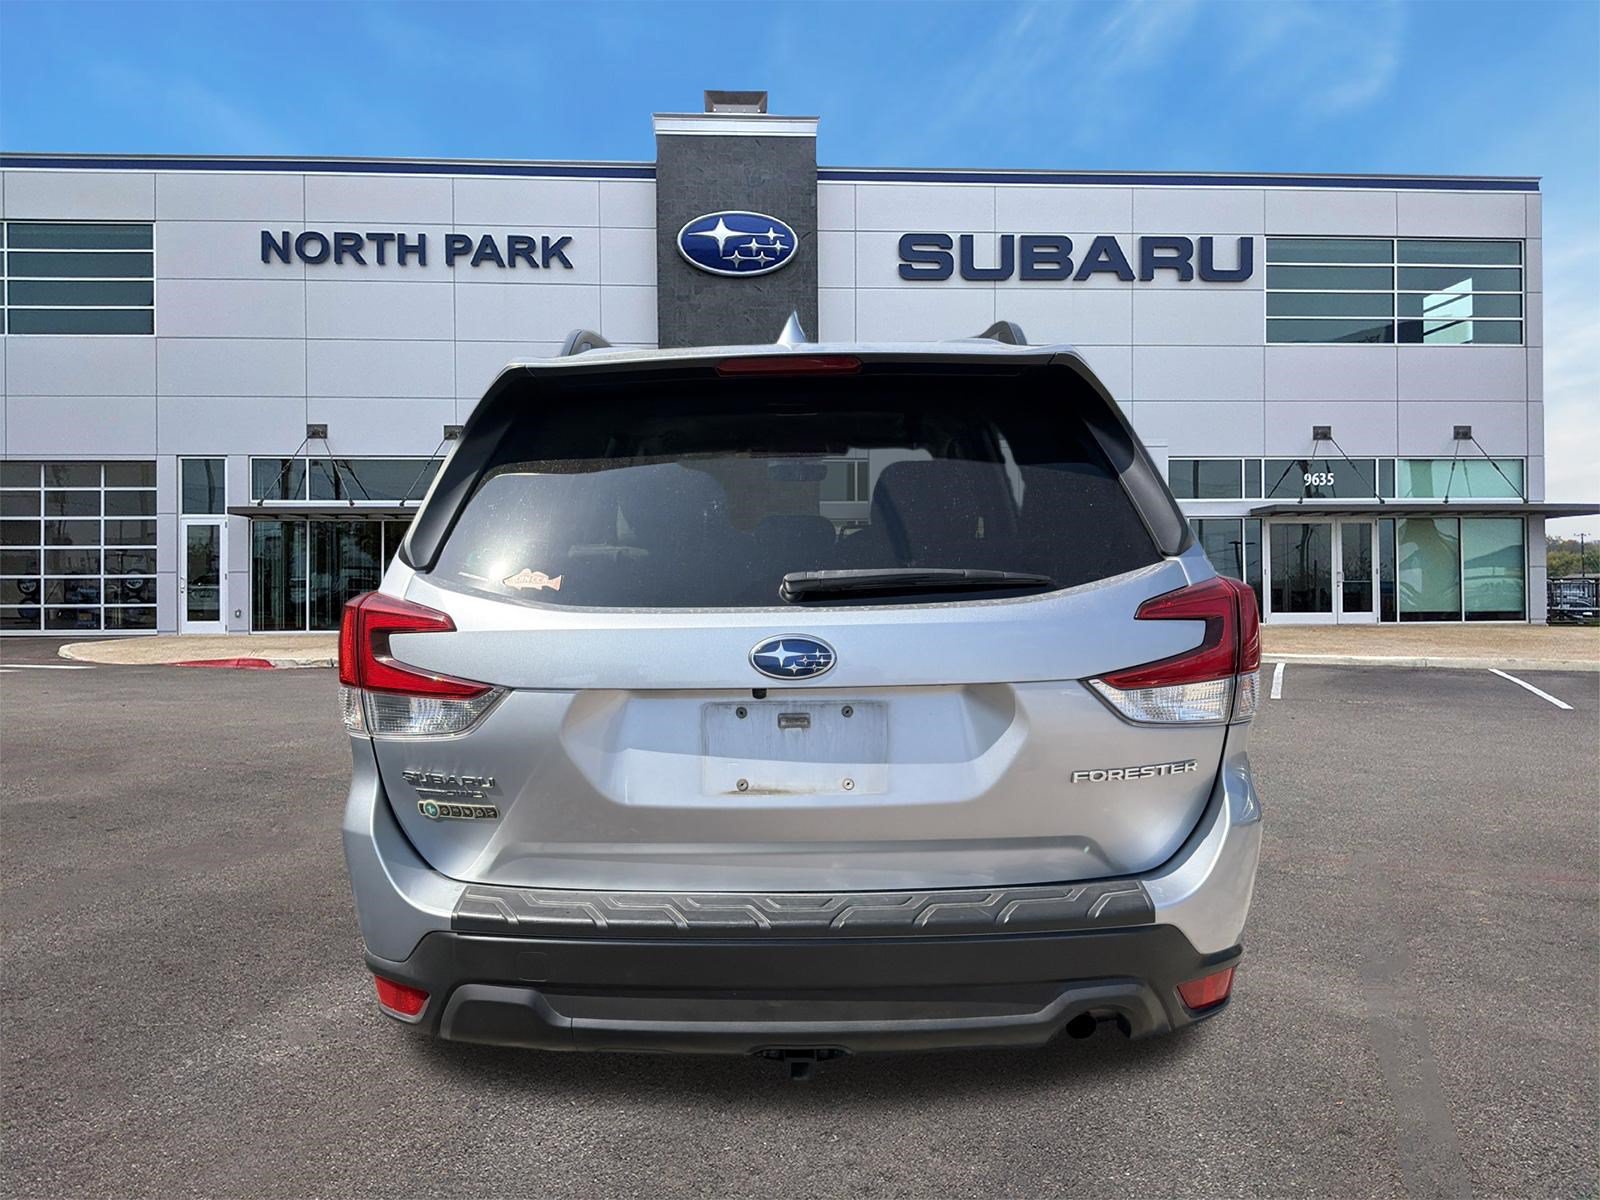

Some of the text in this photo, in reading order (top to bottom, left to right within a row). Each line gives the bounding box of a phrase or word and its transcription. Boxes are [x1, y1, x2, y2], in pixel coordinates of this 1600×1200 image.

[260, 230, 574, 269] NORTH PARK
[898, 233, 1254, 282] SUBARU
[1303, 472, 1335, 486] 9635
[401, 769, 496, 788] SUBARU
[1071, 758, 1199, 784] FORESTER
